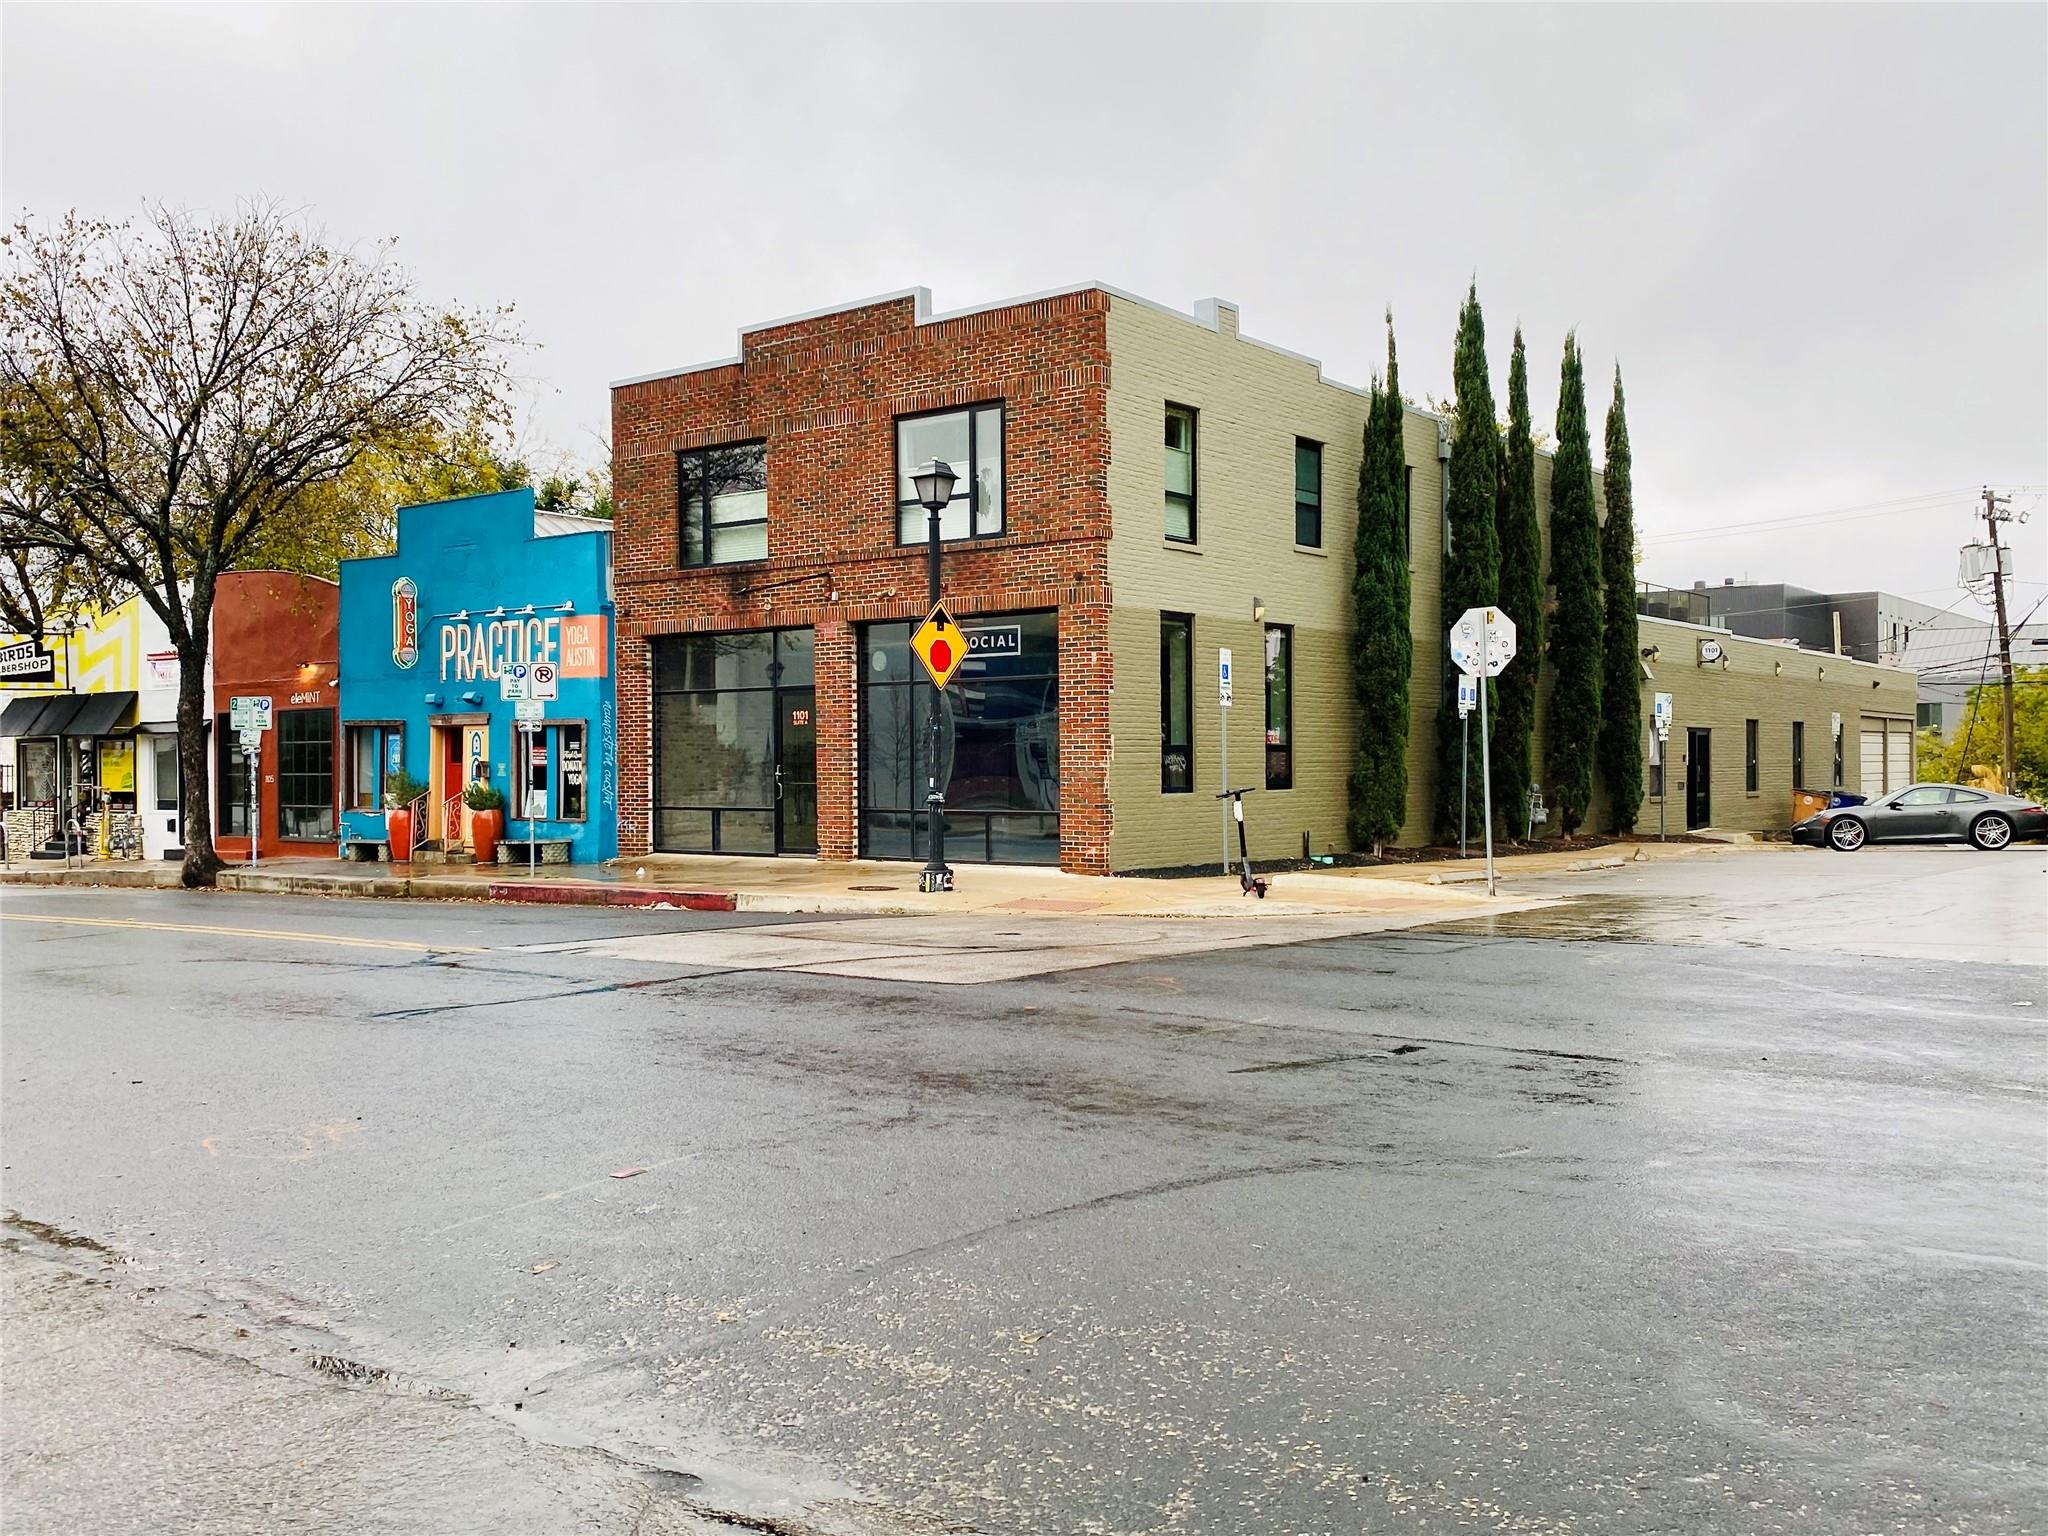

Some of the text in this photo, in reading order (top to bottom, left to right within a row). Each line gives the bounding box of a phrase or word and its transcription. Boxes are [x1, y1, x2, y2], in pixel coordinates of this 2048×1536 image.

[405, 600, 415, 646] YOGA
[565, 625, 589, 644] YOGA
[968, 634, 1016, 648] OCIAL
[441, 618, 559, 681] PRACTICE
[565, 647, 595, 667] AUSTIN
[0, 659, 48, 673] BERSHOP
[290, 691, 320, 704] eleMINT
[793, 711, 808, 719] 1101
